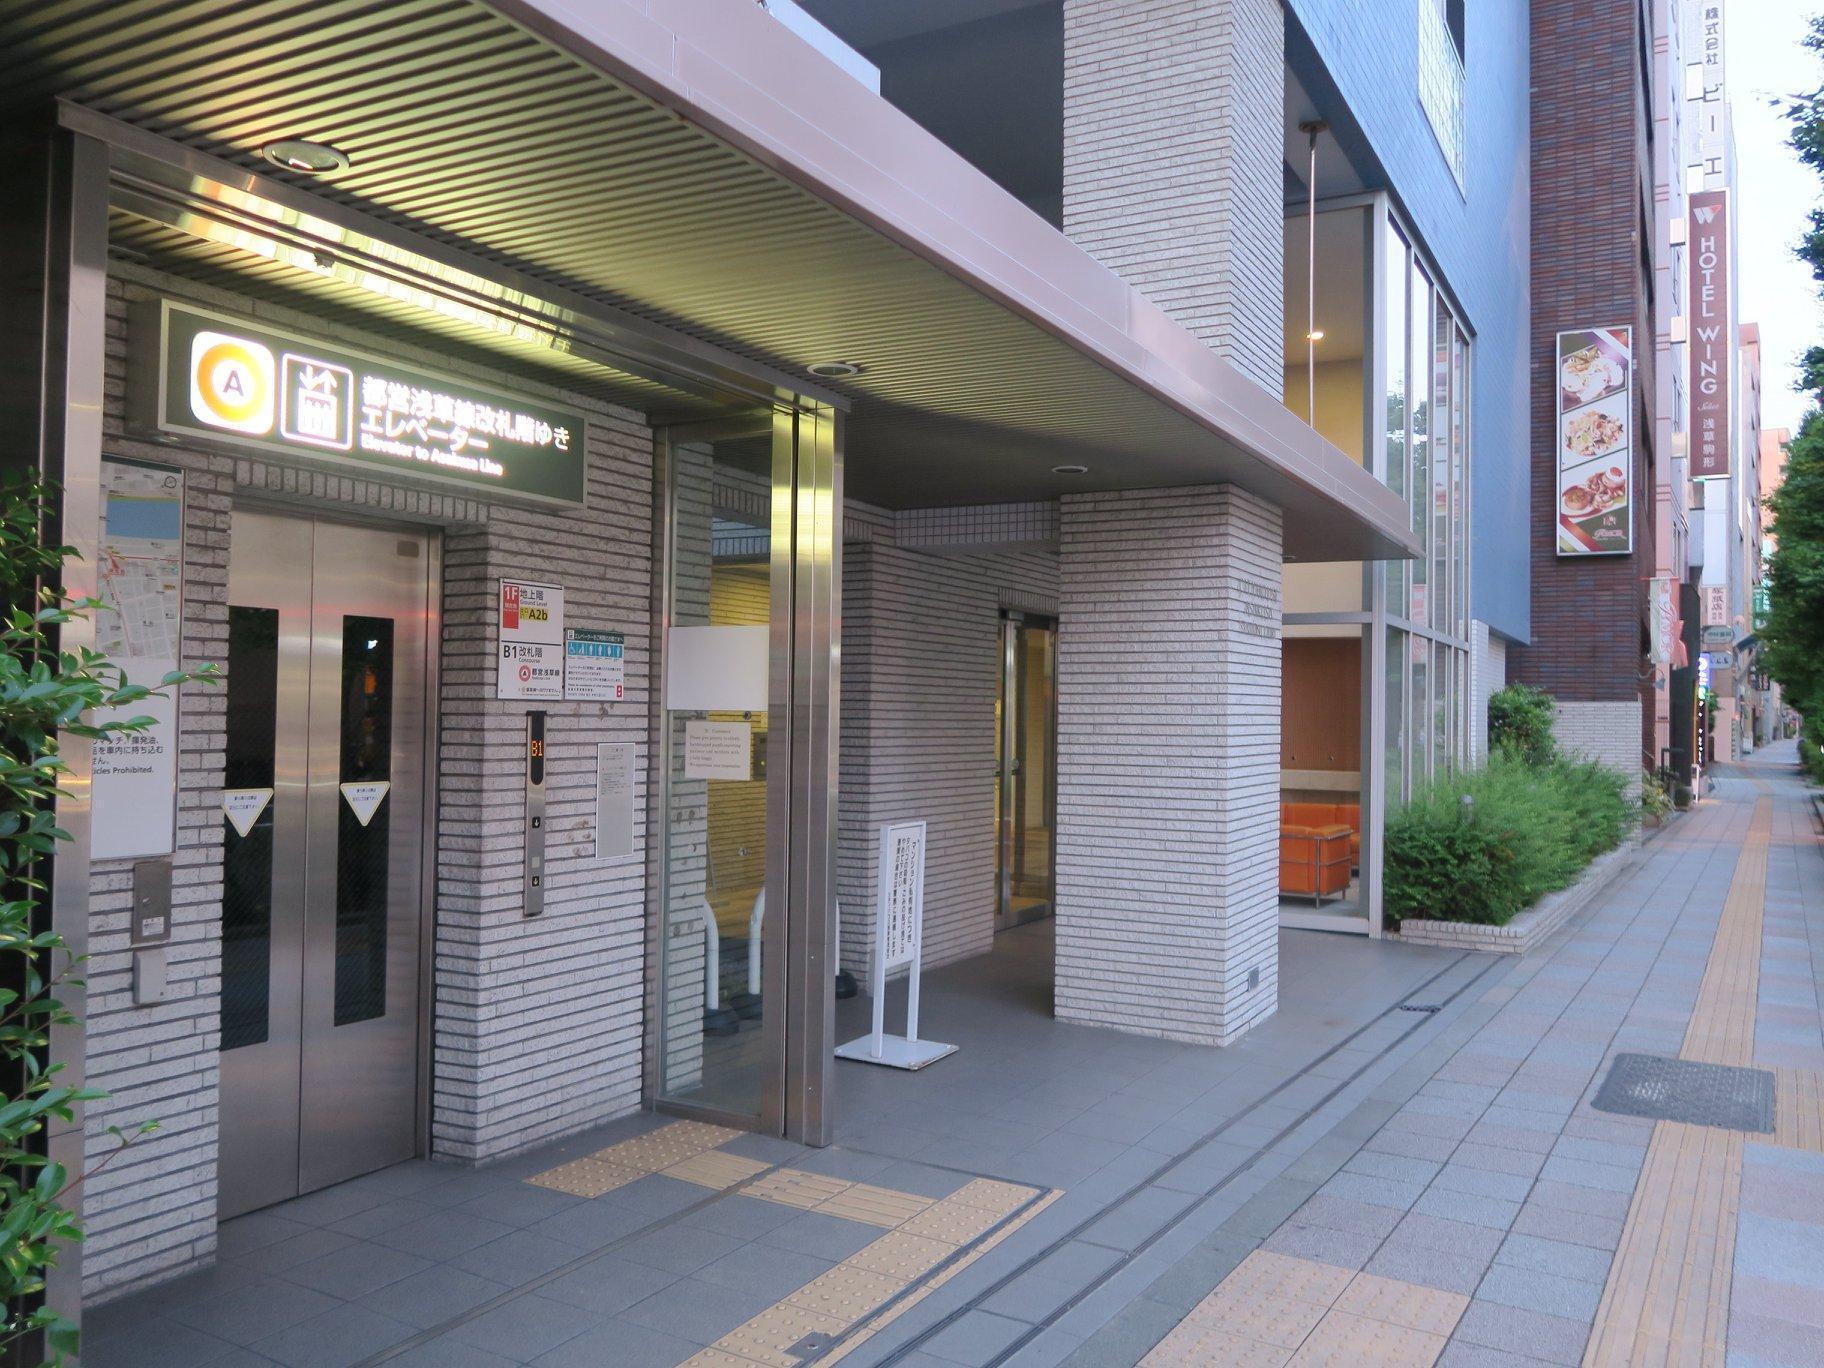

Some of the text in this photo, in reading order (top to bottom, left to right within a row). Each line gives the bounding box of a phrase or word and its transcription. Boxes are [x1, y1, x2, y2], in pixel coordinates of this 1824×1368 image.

[1704, 7, 1719, 65] 株式会社
[1696, 236, 1720, 395] HOTEL WING
[222, 369, 244, 396] A
[361, 406, 489, 451] エレベーター
[504, 587, 518, 600] 1F
[520, 589, 544, 601] 地上階
[528, 608, 548, 621] A2b
[503, 645, 517, 659] B1
[518, 646, 543, 658] 改札階
[531, 740, 543, 756] B1
[112, 765, 154, 775] Prohibited.
